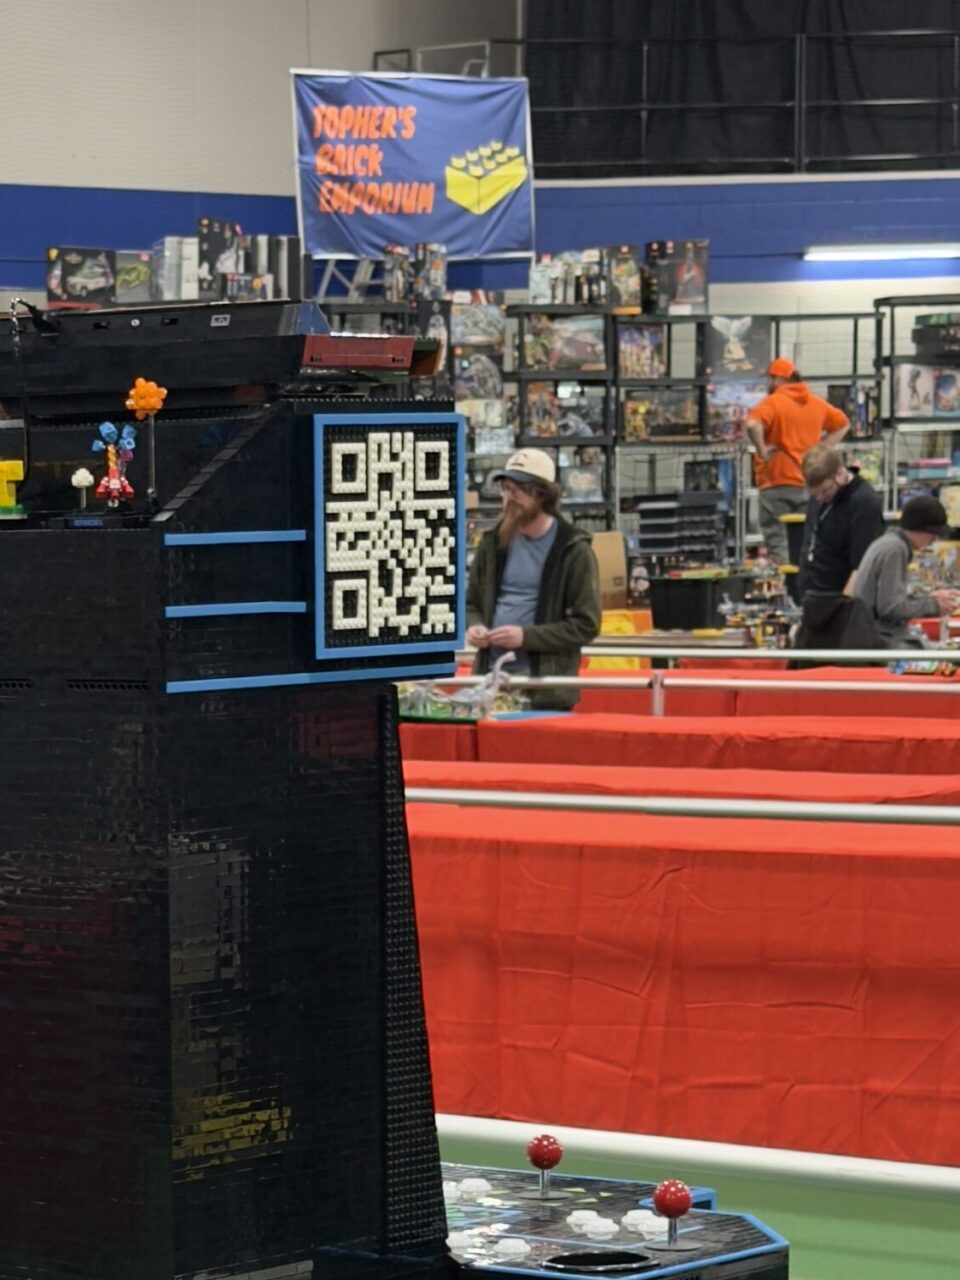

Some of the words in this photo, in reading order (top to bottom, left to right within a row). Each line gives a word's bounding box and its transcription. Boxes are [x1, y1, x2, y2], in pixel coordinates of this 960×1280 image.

[313, 104, 416, 139] TOPHER'S
[315, 143, 383, 176] BRICK
[318, 180, 435, 215] EMPORIUM
